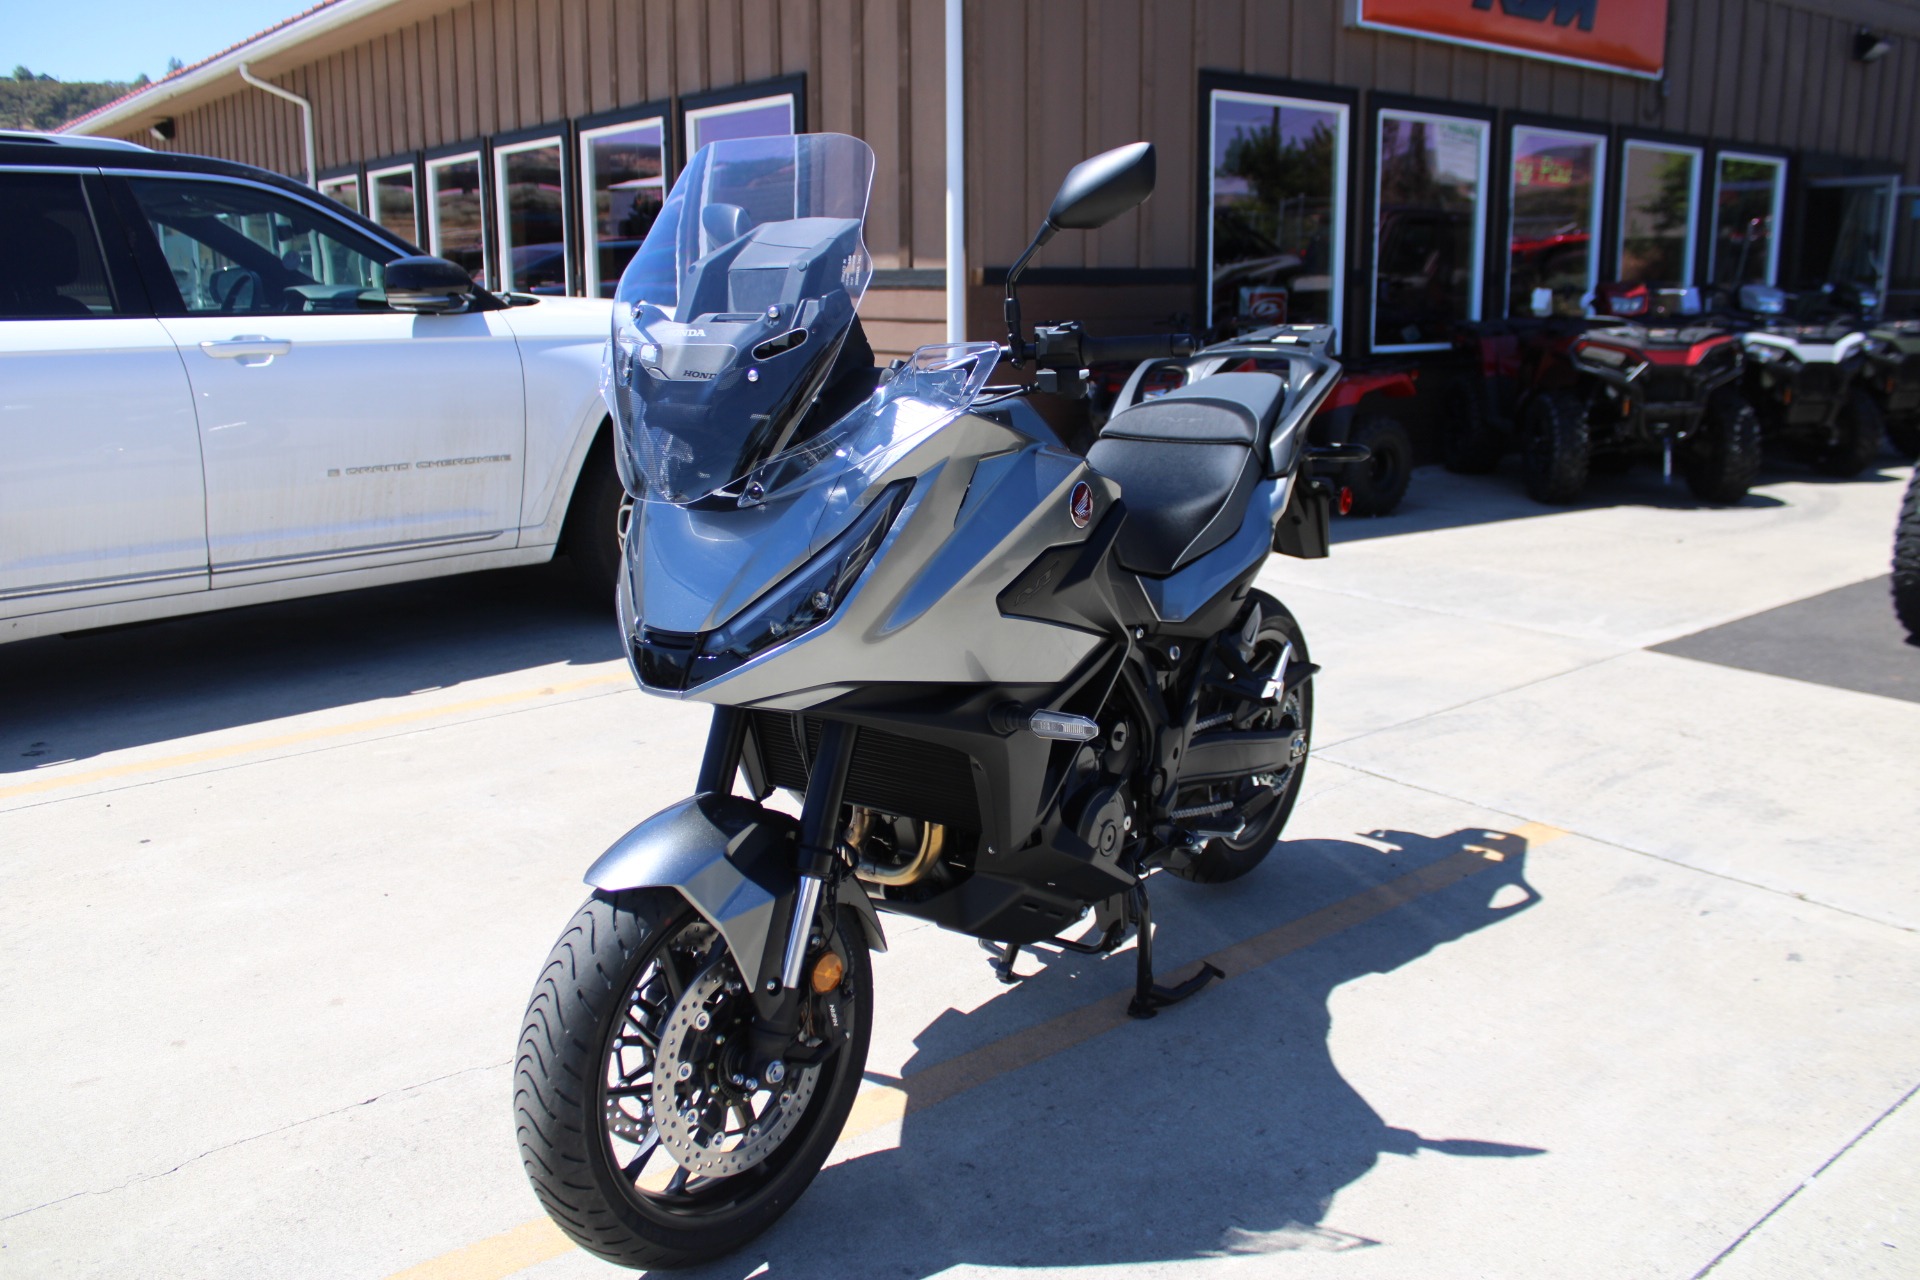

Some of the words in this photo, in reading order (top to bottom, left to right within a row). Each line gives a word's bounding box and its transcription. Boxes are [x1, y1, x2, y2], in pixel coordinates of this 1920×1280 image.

[665, 328, 706, 337] ONDA
[683, 369, 718, 379] HON
[416, 454, 512, 469] CHEROKEE
